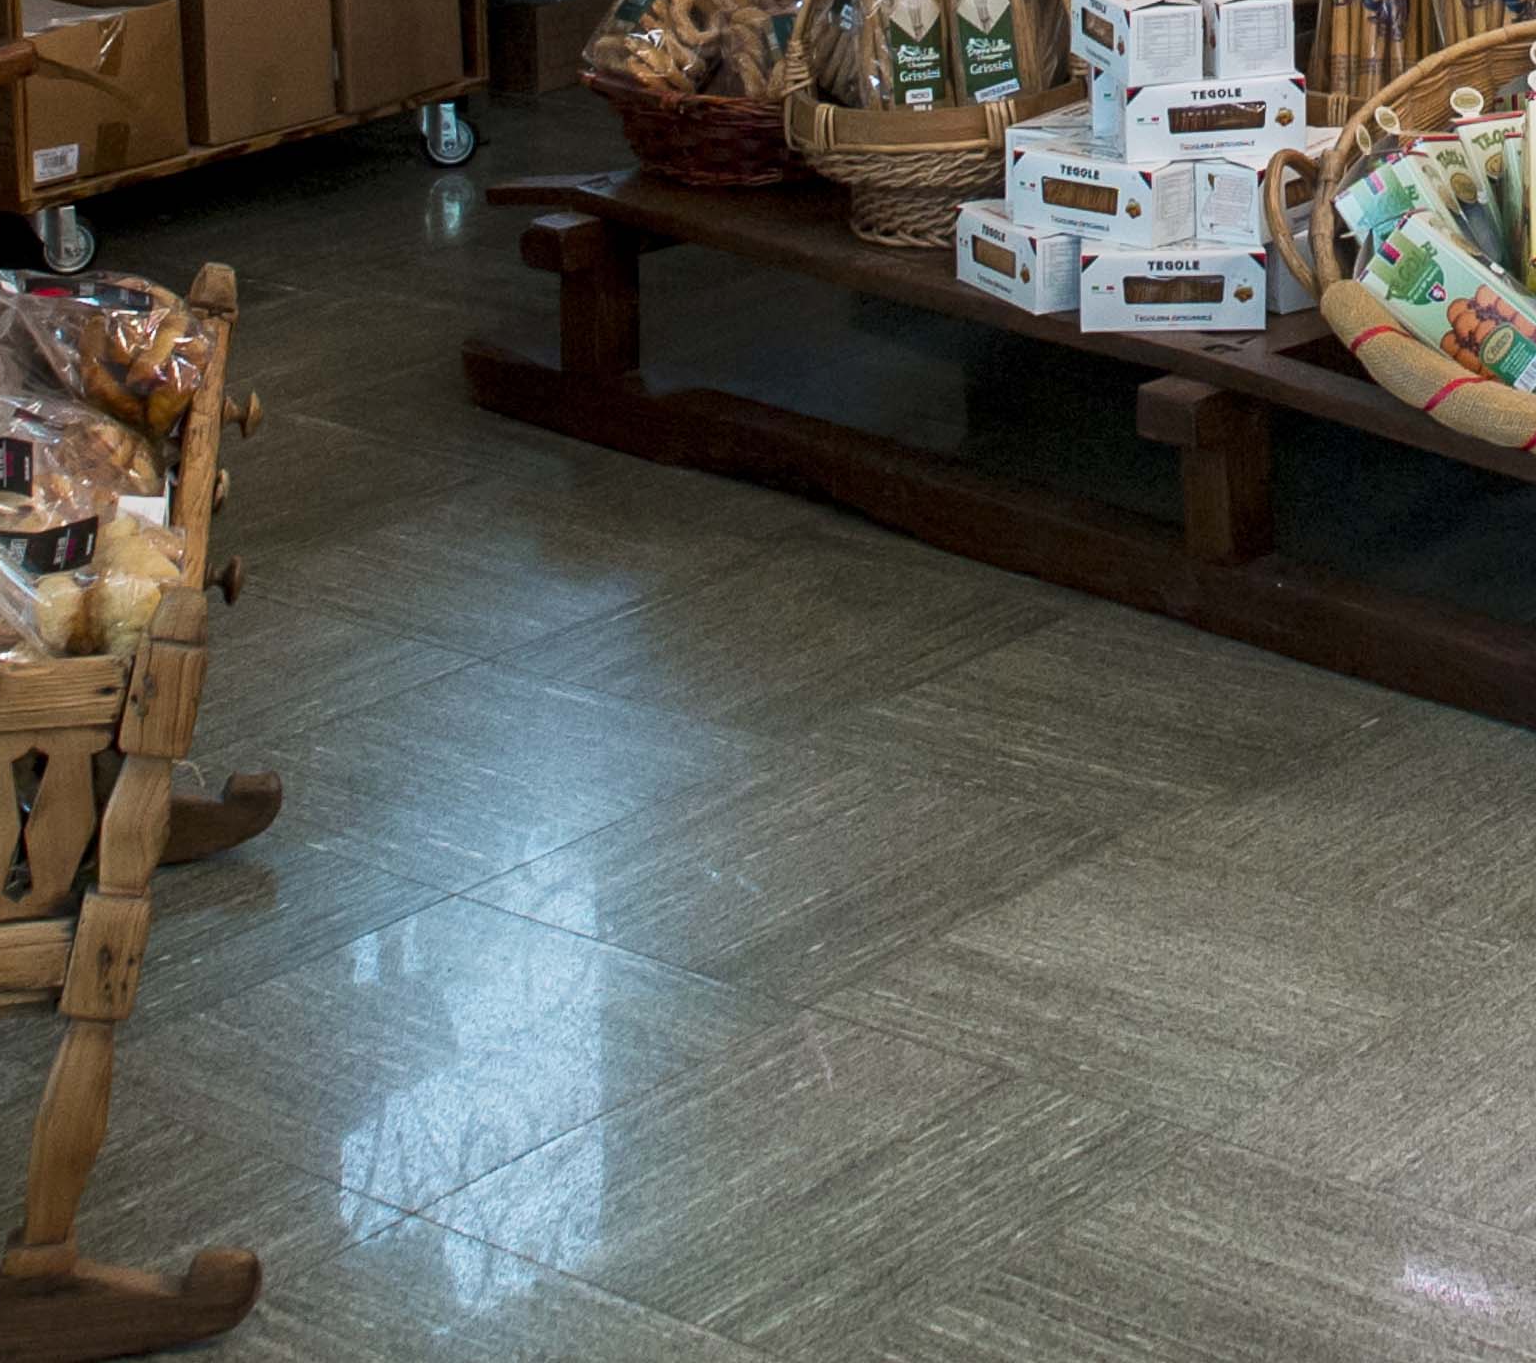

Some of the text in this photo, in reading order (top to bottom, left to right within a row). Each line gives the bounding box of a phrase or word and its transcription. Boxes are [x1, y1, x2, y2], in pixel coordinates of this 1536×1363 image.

[969, 60, 1013, 75] Grissini
[900, 68, 941, 82] Grissini
[1191, 88, 1243, 100] TEGOLE
[1060, 164, 1101, 181] TEGOLE
[1147, 260, 1201, 271] TEGOLE
